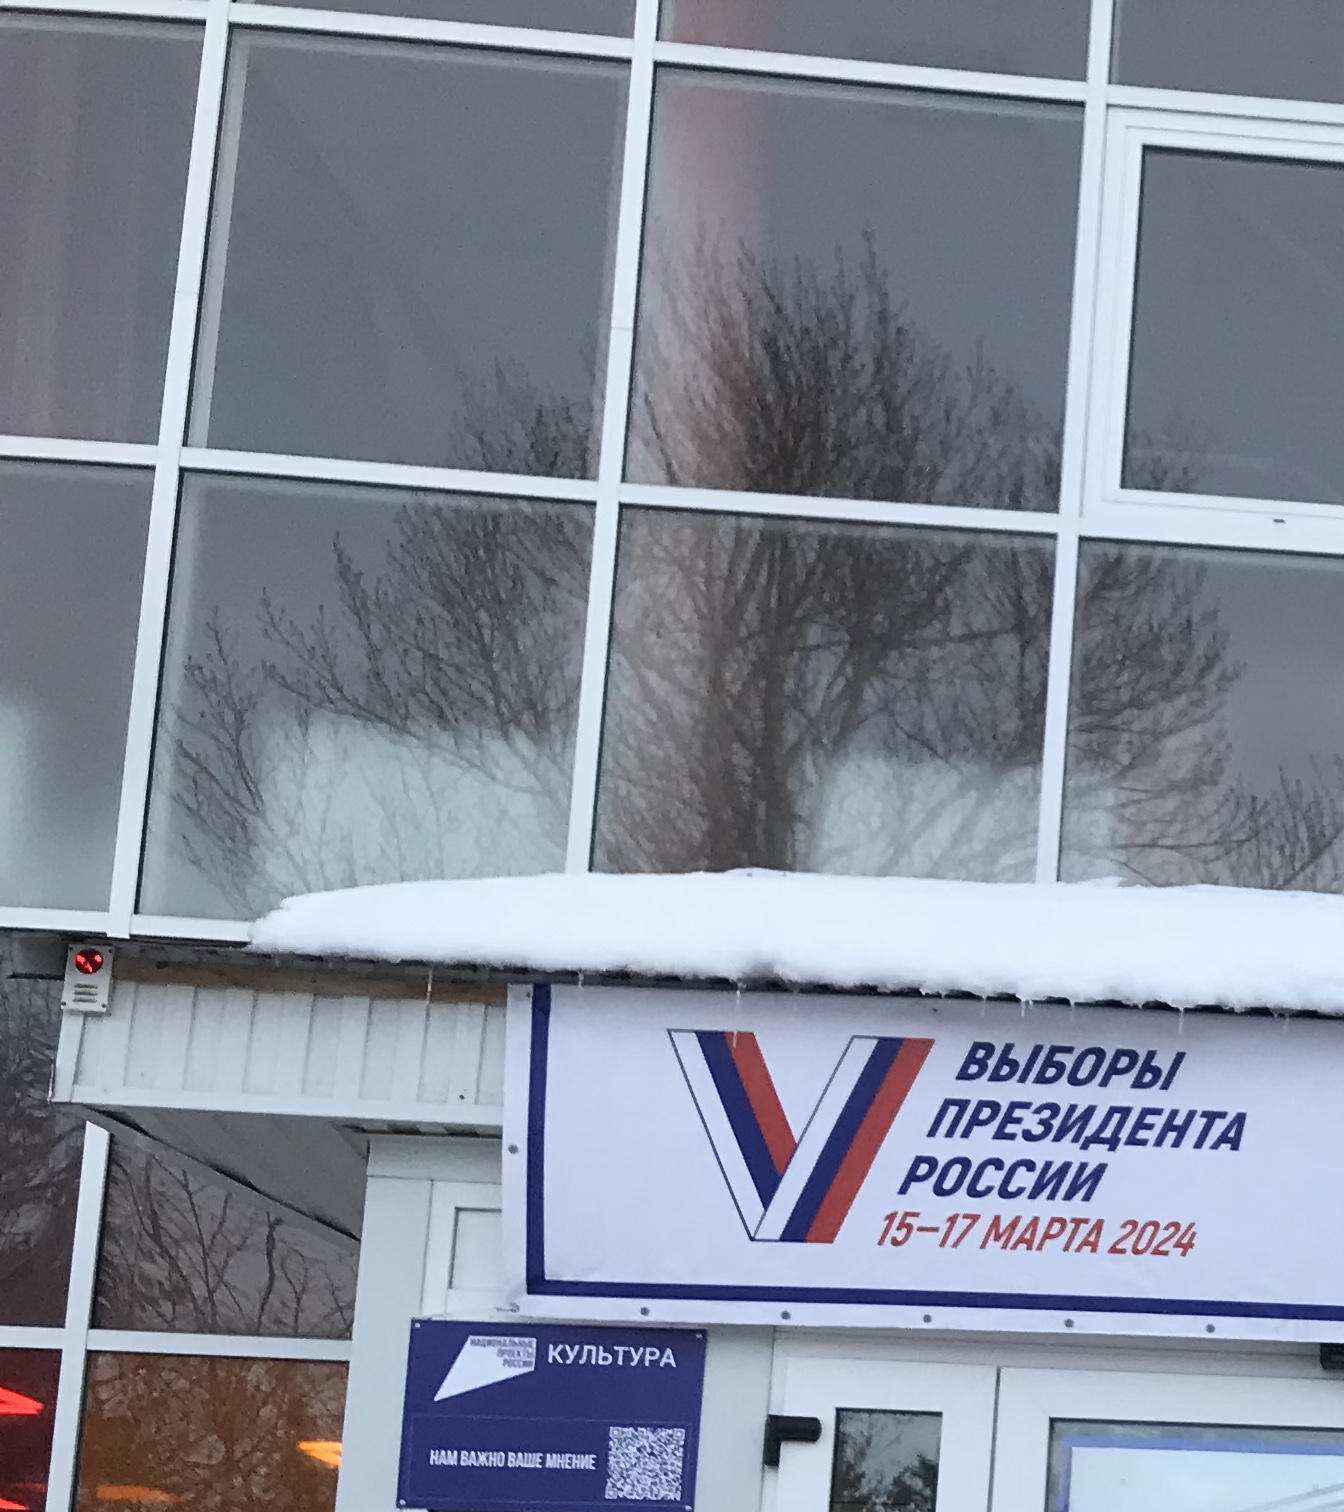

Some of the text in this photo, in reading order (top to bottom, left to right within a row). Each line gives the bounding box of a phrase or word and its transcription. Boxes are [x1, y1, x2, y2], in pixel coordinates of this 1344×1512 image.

[955, 1041, 1186, 1092] ВЫБОРЫ
[926, 1098, 1248, 1153] ПРЕЗИДЕНТА
[897, 1155, 1108, 1203] РОССИИ
[979, 1214, 1104, 1256] МАРТА
[1107, 1219, 1197, 1259] 2024
[547, 1344, 676, 1368] КУЛЬТУРА
[430, 1449, 596, 1471] НАМ ВАЖНО ВАШЕ МНЕНИЕ
